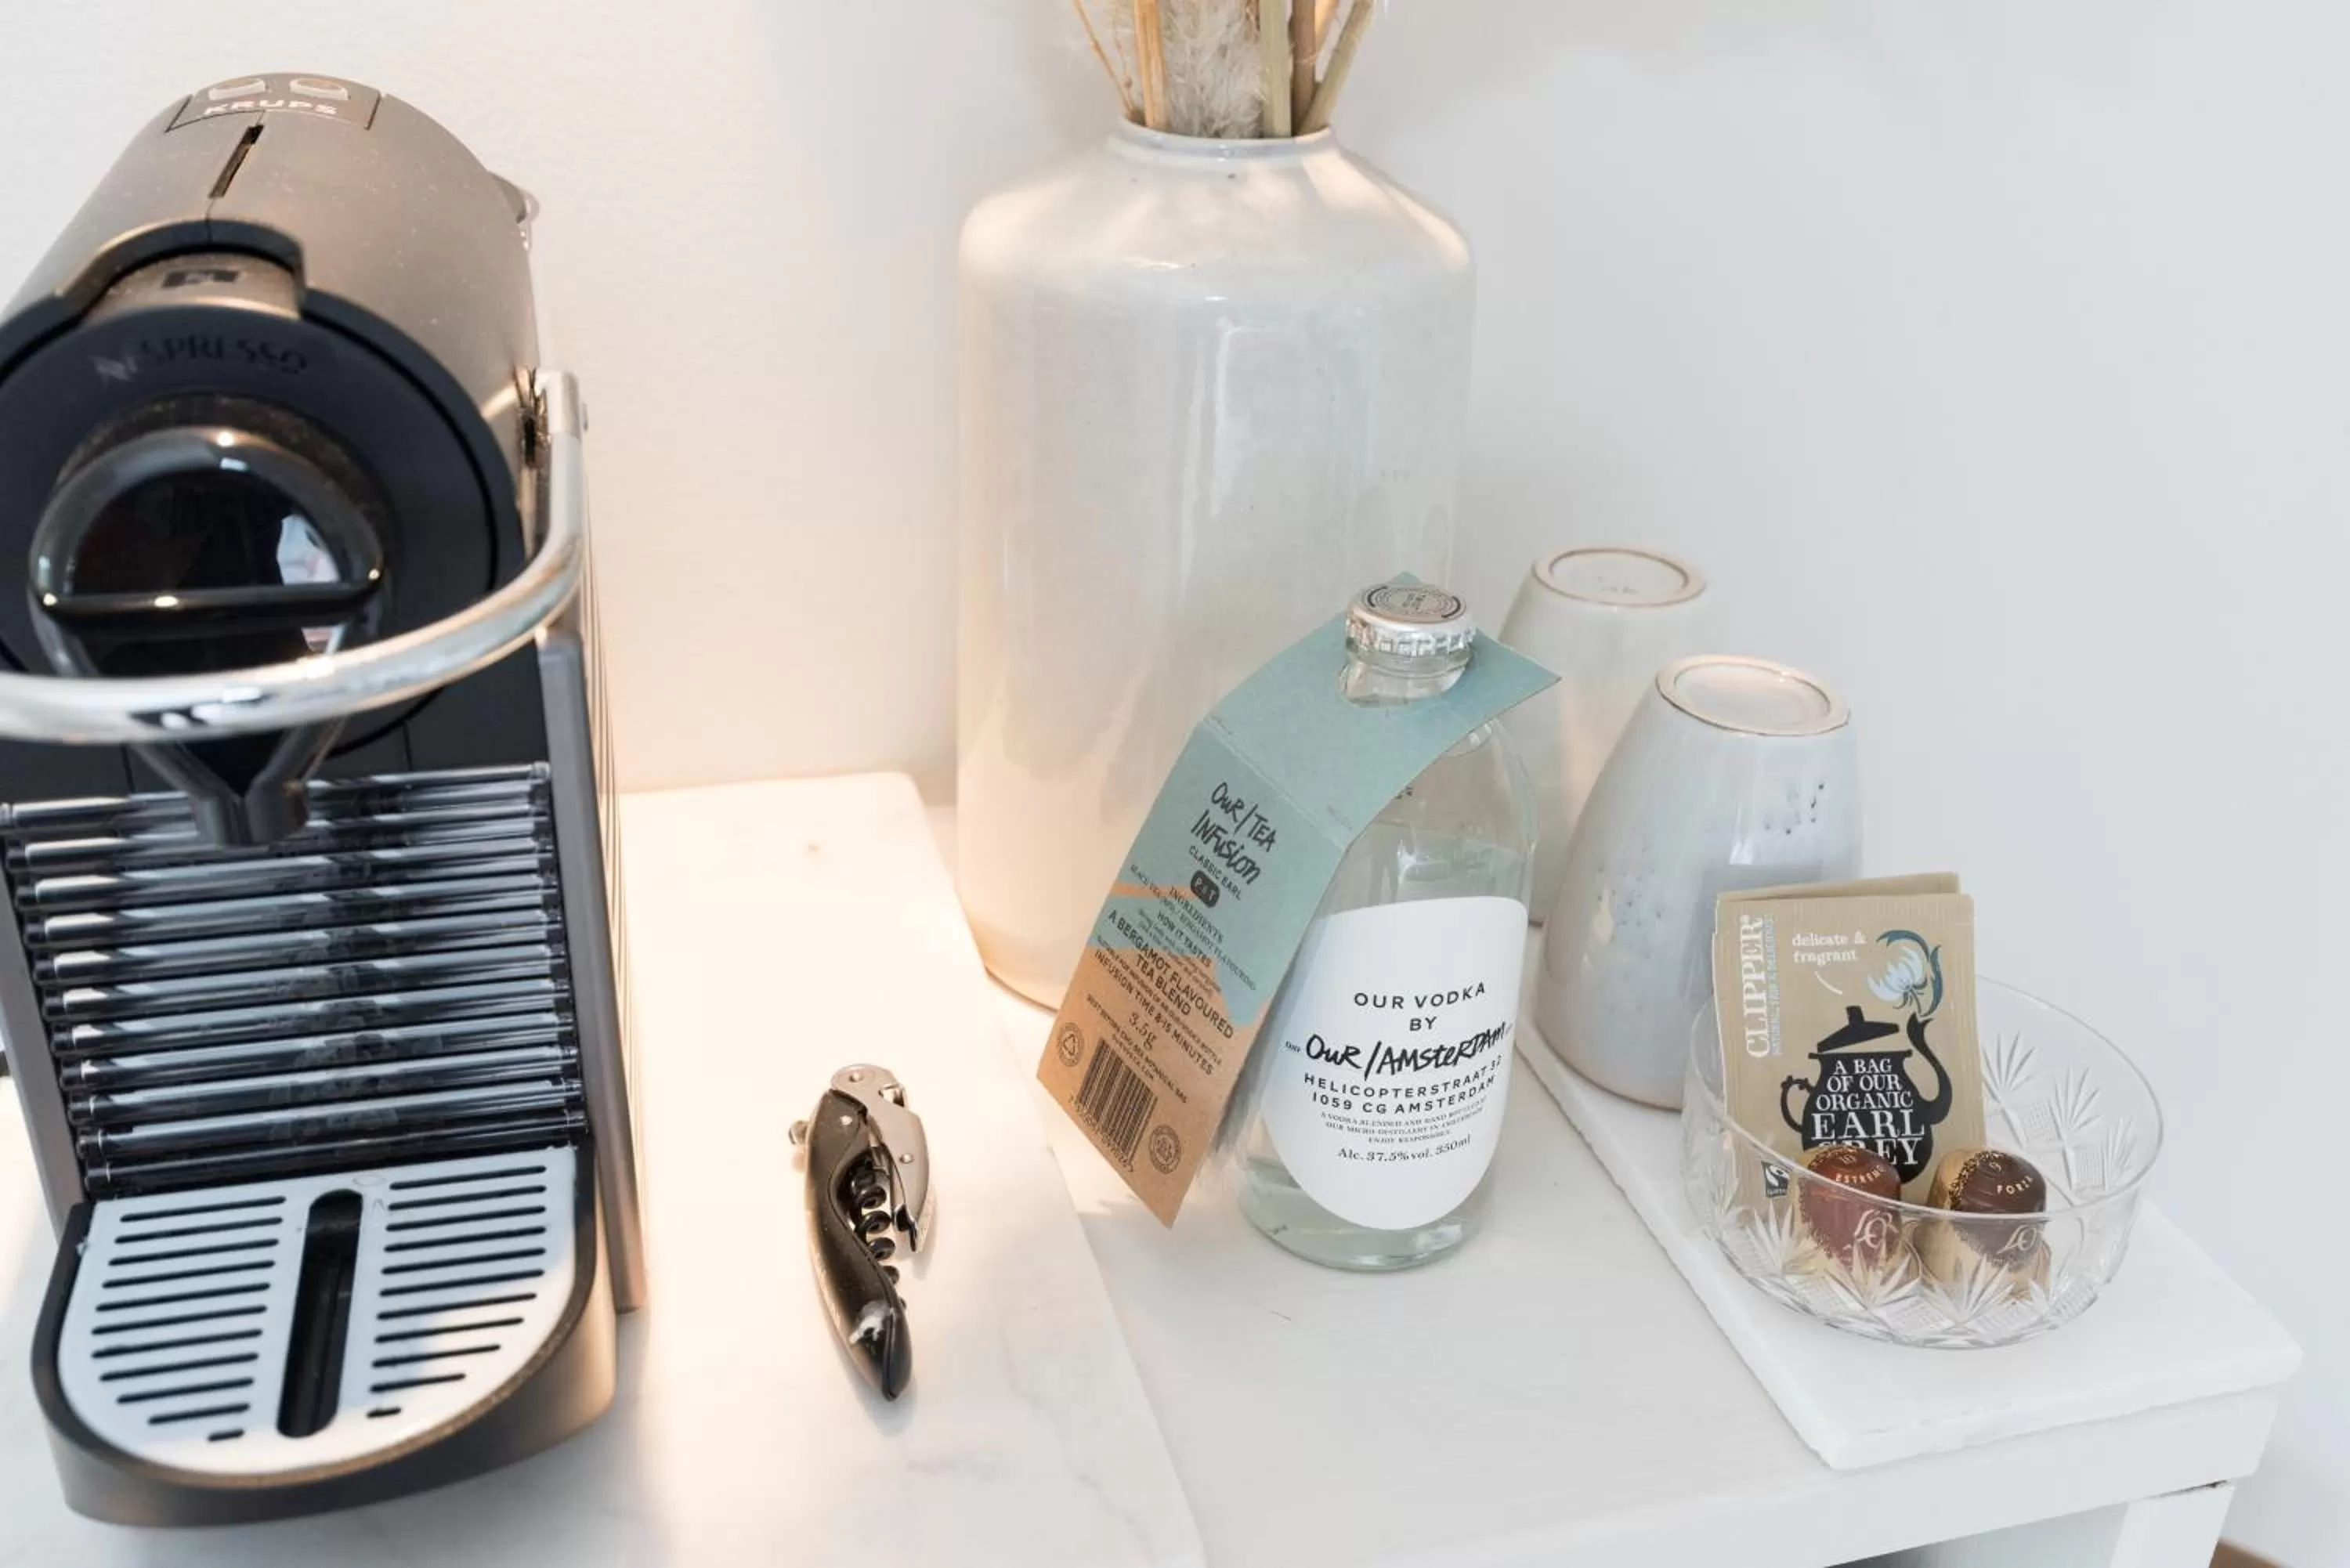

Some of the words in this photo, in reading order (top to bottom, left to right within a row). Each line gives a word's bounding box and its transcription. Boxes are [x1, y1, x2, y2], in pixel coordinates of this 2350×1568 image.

[204, 99, 337, 115] KRUPS
[1188, 844, 1220, 880] CLASSIC
[1220, 875, 1242, 900] EARL
[1791, 932, 1849, 947] delicate
[1854, 930, 1867, 944] &
[1794, 949, 1857, 966] fragrant
[1108, 908, 1117, 923] A
[1117, 916, 1170, 977] BERGAMOT
[1170, 970, 1234, 1040] FLAVOURED
[1134, 953, 1155, 981] TEA
[1155, 975, 1191, 1017] BLEND
[1740, 917, 1770, 1058] CLIPPER
[1354, 992, 1405, 1010] OUR
[1414, 981, 1486, 1009] VODKA
[1094, 948, 1133, 994] INFUSION
[1133, 989, 1154, 1015] TIME
[1172, 1028, 1213, 1075] MINUTES
[1409, 1016, 1437, 1031] BY
[1833, 1060, 1849, 1075] A
[1853, 1058, 1893, 1074] BAG
[1303, 1066, 1488, 1097] HELICOPTERSTRAAT
[1312, 1091, 1354, 1111] 1059
[1362, 1102, 1387, 1115] CG
[1394, 1075, 1495, 1115] AMSTERDAM
[1827, 1075, 1853, 1093] OF
[1859, 1074, 1904, 1092] OUR
[1816, 1090, 1914, 1111] ORGANIC
[1811, 1109, 1925, 1140] EARL
[1337, 1147, 1364, 1161] Alc.
[1410, 1147, 1433, 1160] vol.
[1818, 1137, 1923, 1165] EY
